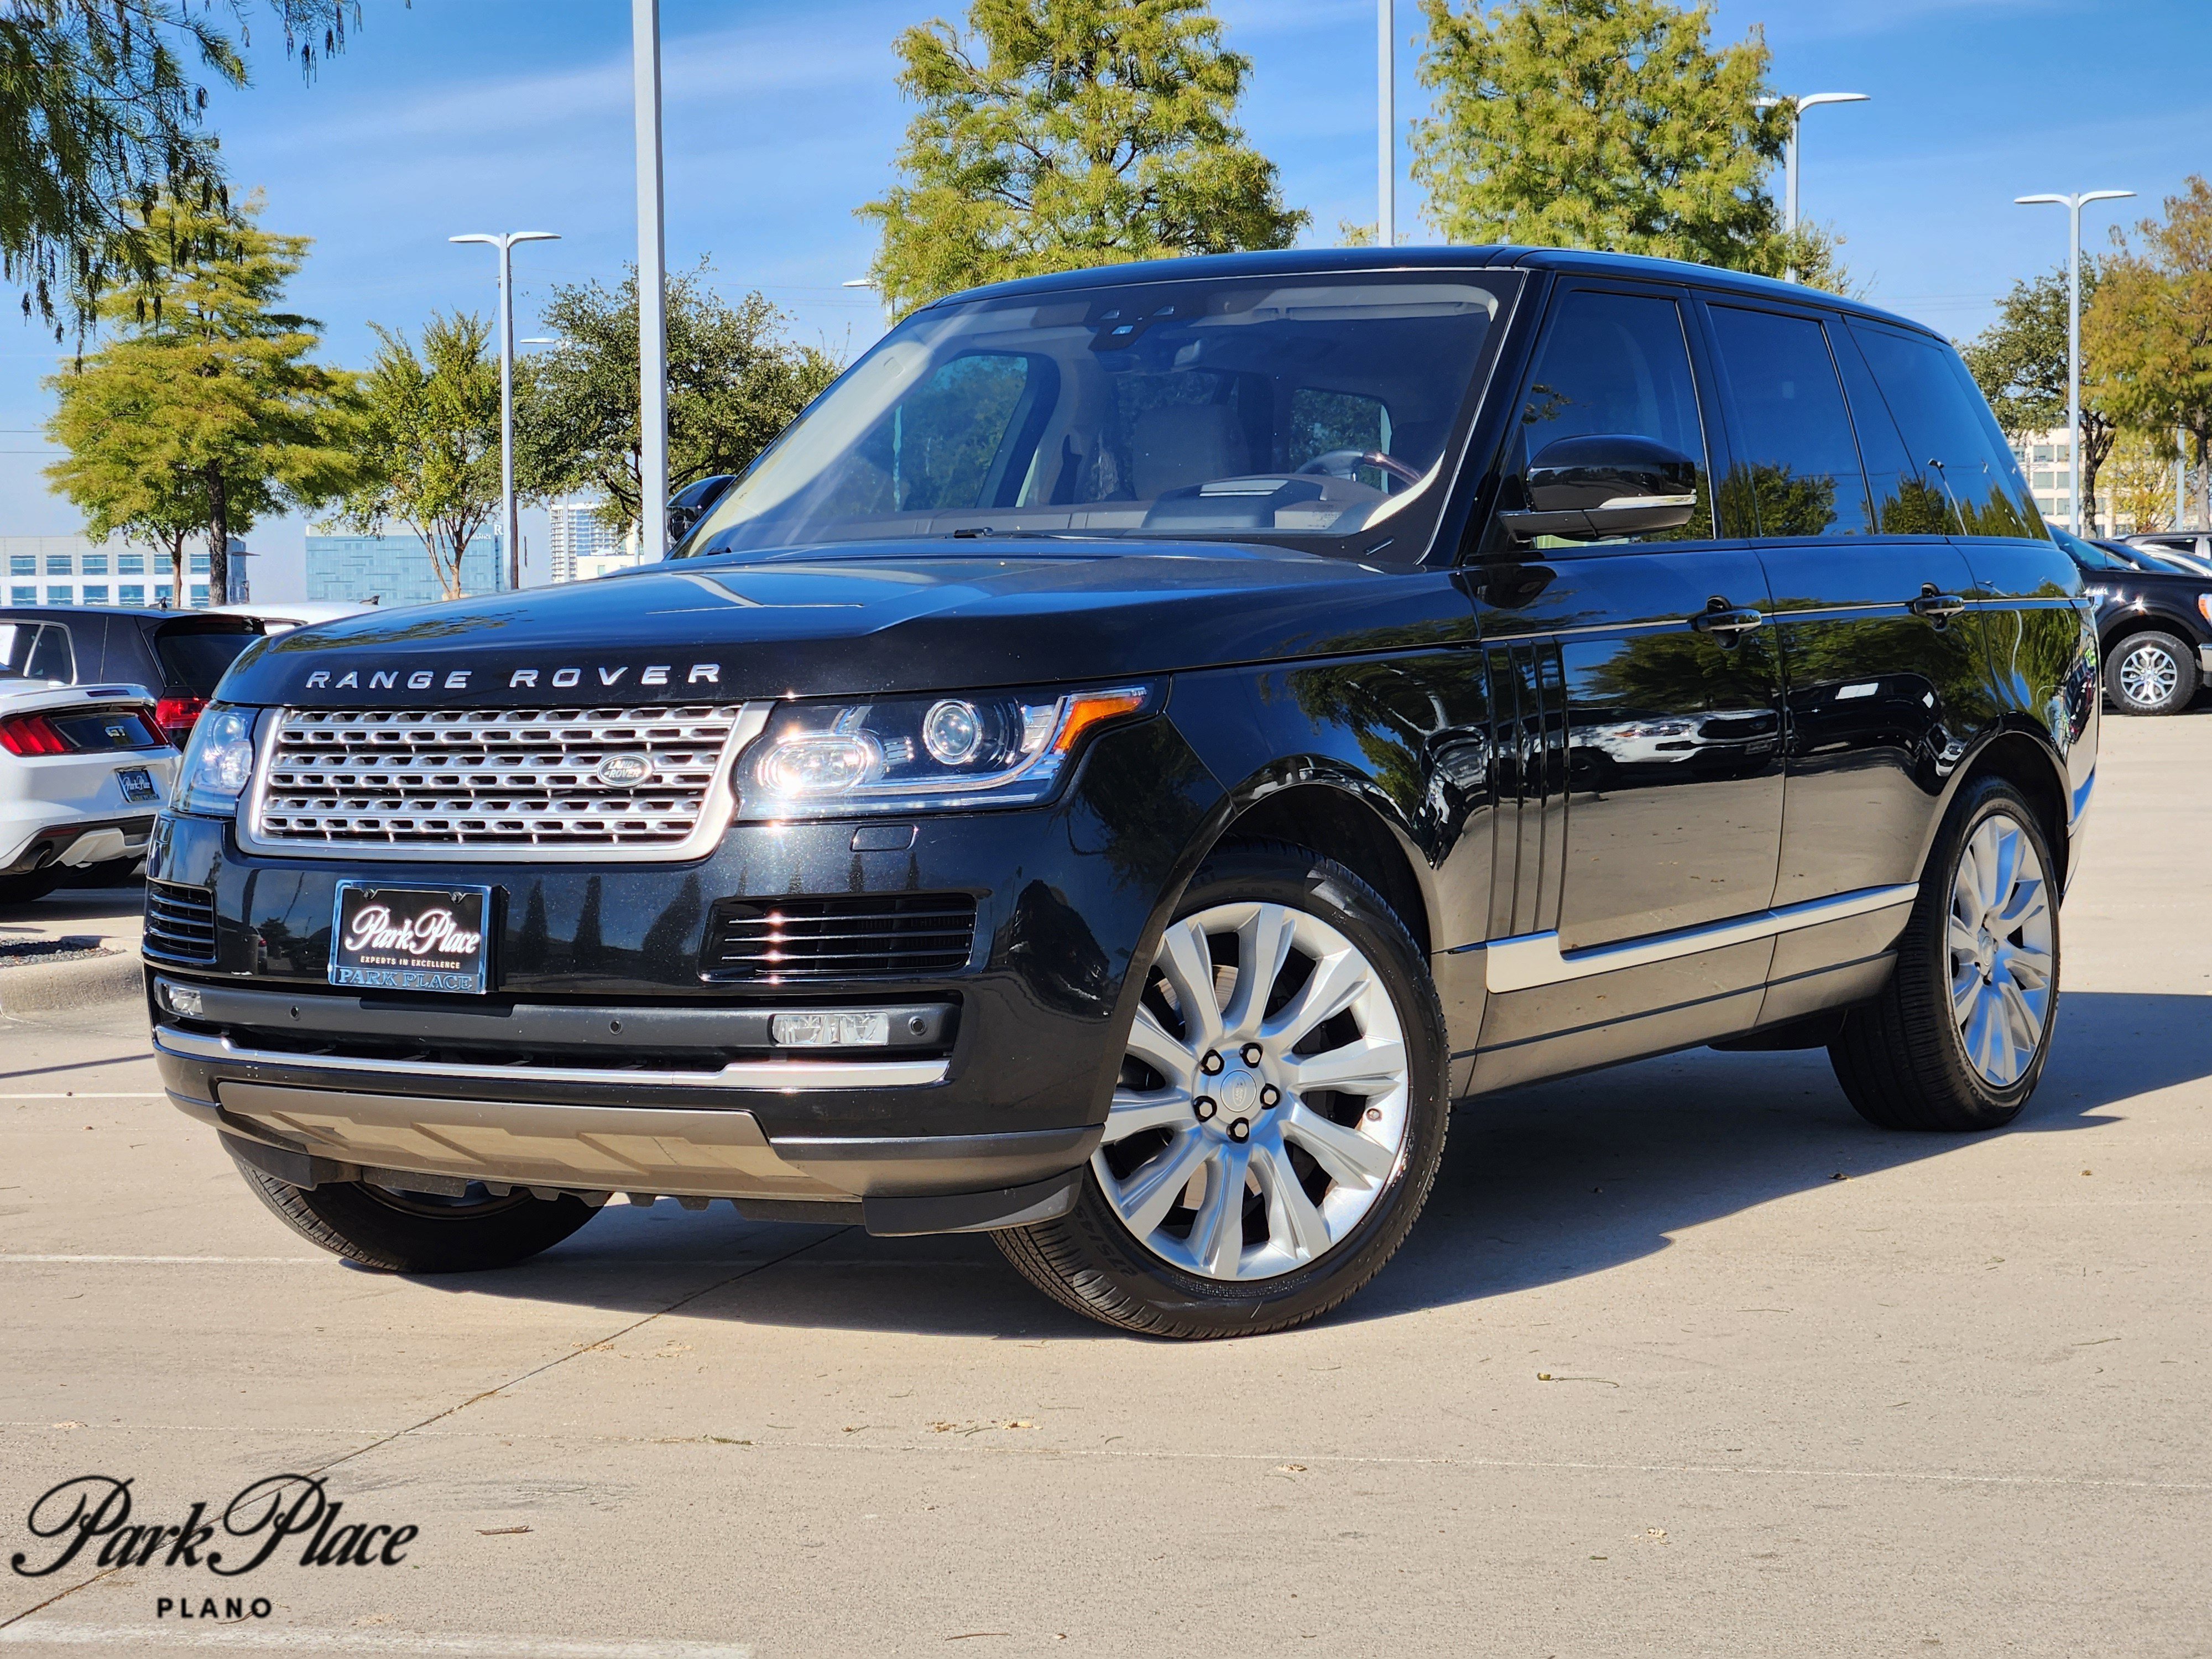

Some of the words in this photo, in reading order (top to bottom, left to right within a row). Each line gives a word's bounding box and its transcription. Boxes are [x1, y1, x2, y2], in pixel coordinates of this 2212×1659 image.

[494, 524, 504, 535] R
[305, 670, 472, 690] RANGE
[509, 664, 721, 688] ROVER
[105, 726, 126, 737] GT
[608, 760, 634, 769] LAND
[608, 769, 640, 778] ROVER
[345, 904, 414, 951] Park
[409, 909, 481, 954] Place
[360, 956, 397, 965] EXPERTS
[399, 958, 409, 966] IN
[411, 959, 461, 969] EXCELLENCE
[338, 968, 399, 987] PARK
[402, 972, 473, 990] PLACE
